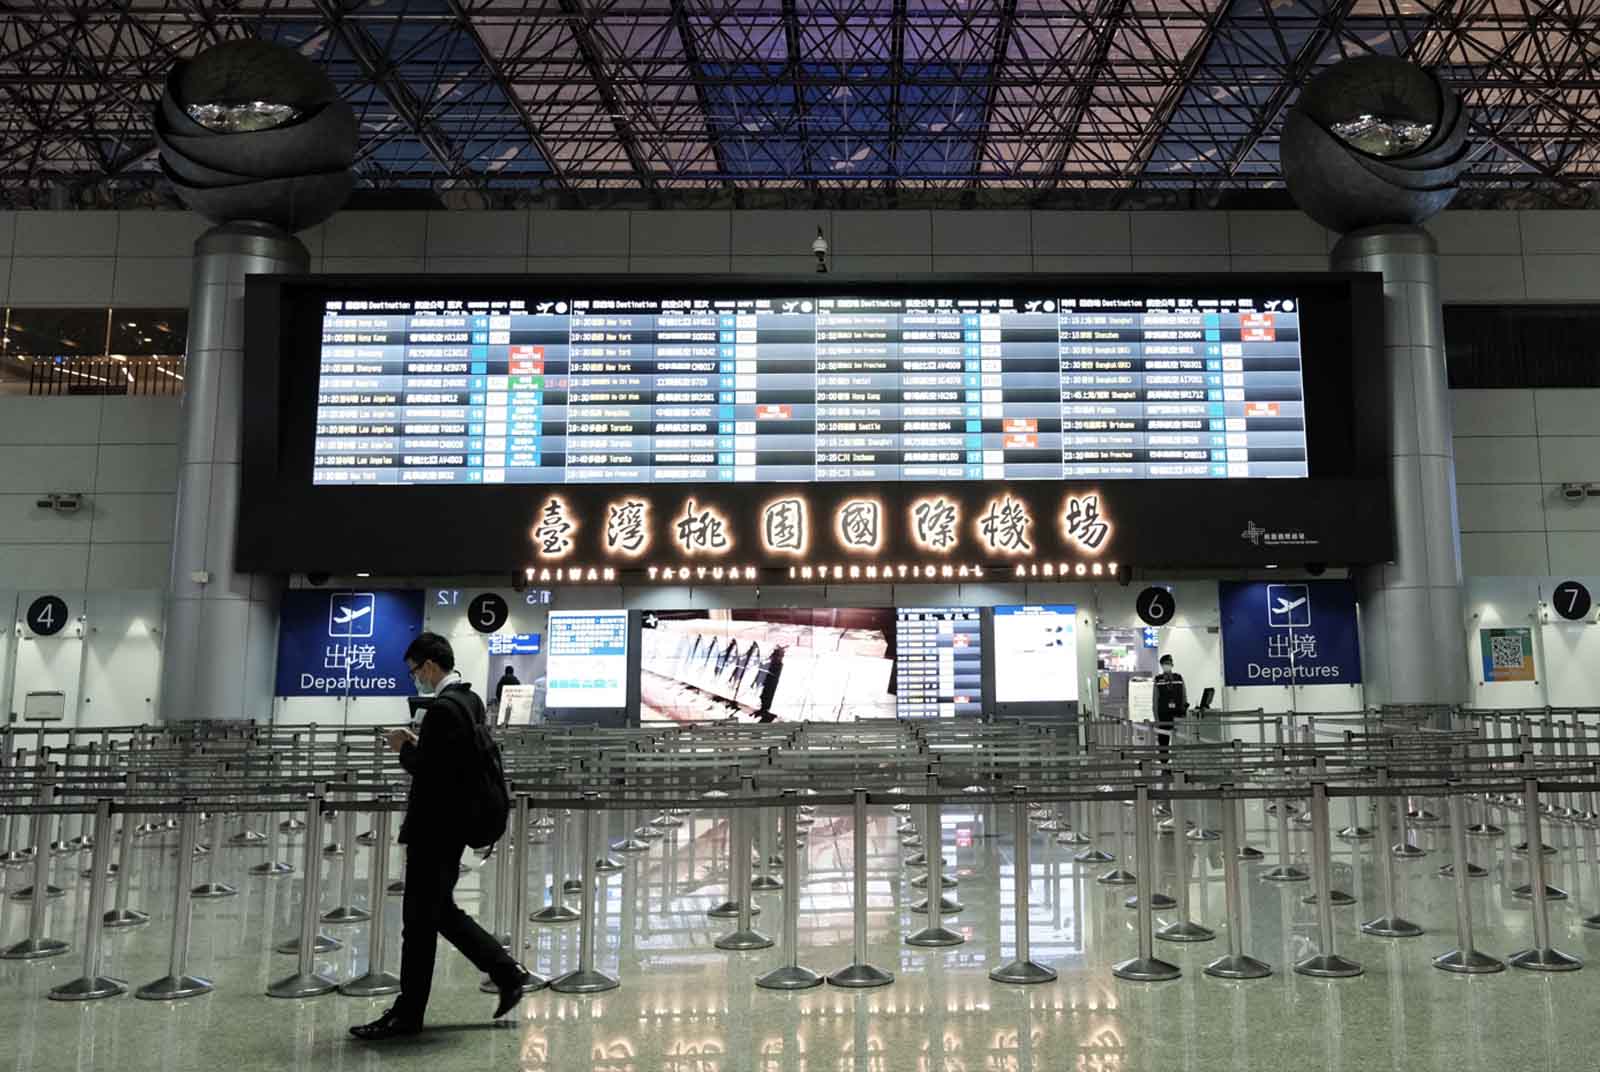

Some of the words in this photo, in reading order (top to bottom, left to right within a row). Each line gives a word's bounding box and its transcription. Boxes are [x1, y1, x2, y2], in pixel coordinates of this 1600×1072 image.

[535, 496, 1108, 554] 臺灣桃園國際機場
[526, 568, 615, 581] TAIWAN
[649, 567, 756, 580] TAOYUAN
[790, 565, 983, 578] INTERNATIONAL
[1016, 563, 1117, 576] AIRPORT
[1148, 594, 1164, 618] 6
[1564, 589, 1578, 612] 7
[37, 603, 54, 628] 4
[480, 600, 496, 626] 5
[324, 644, 376, 670] 出境
[1268, 634, 1317, 658] 出境
[300, 673, 396, 693] Departures
[1248, 663, 1340, 682] Departures
